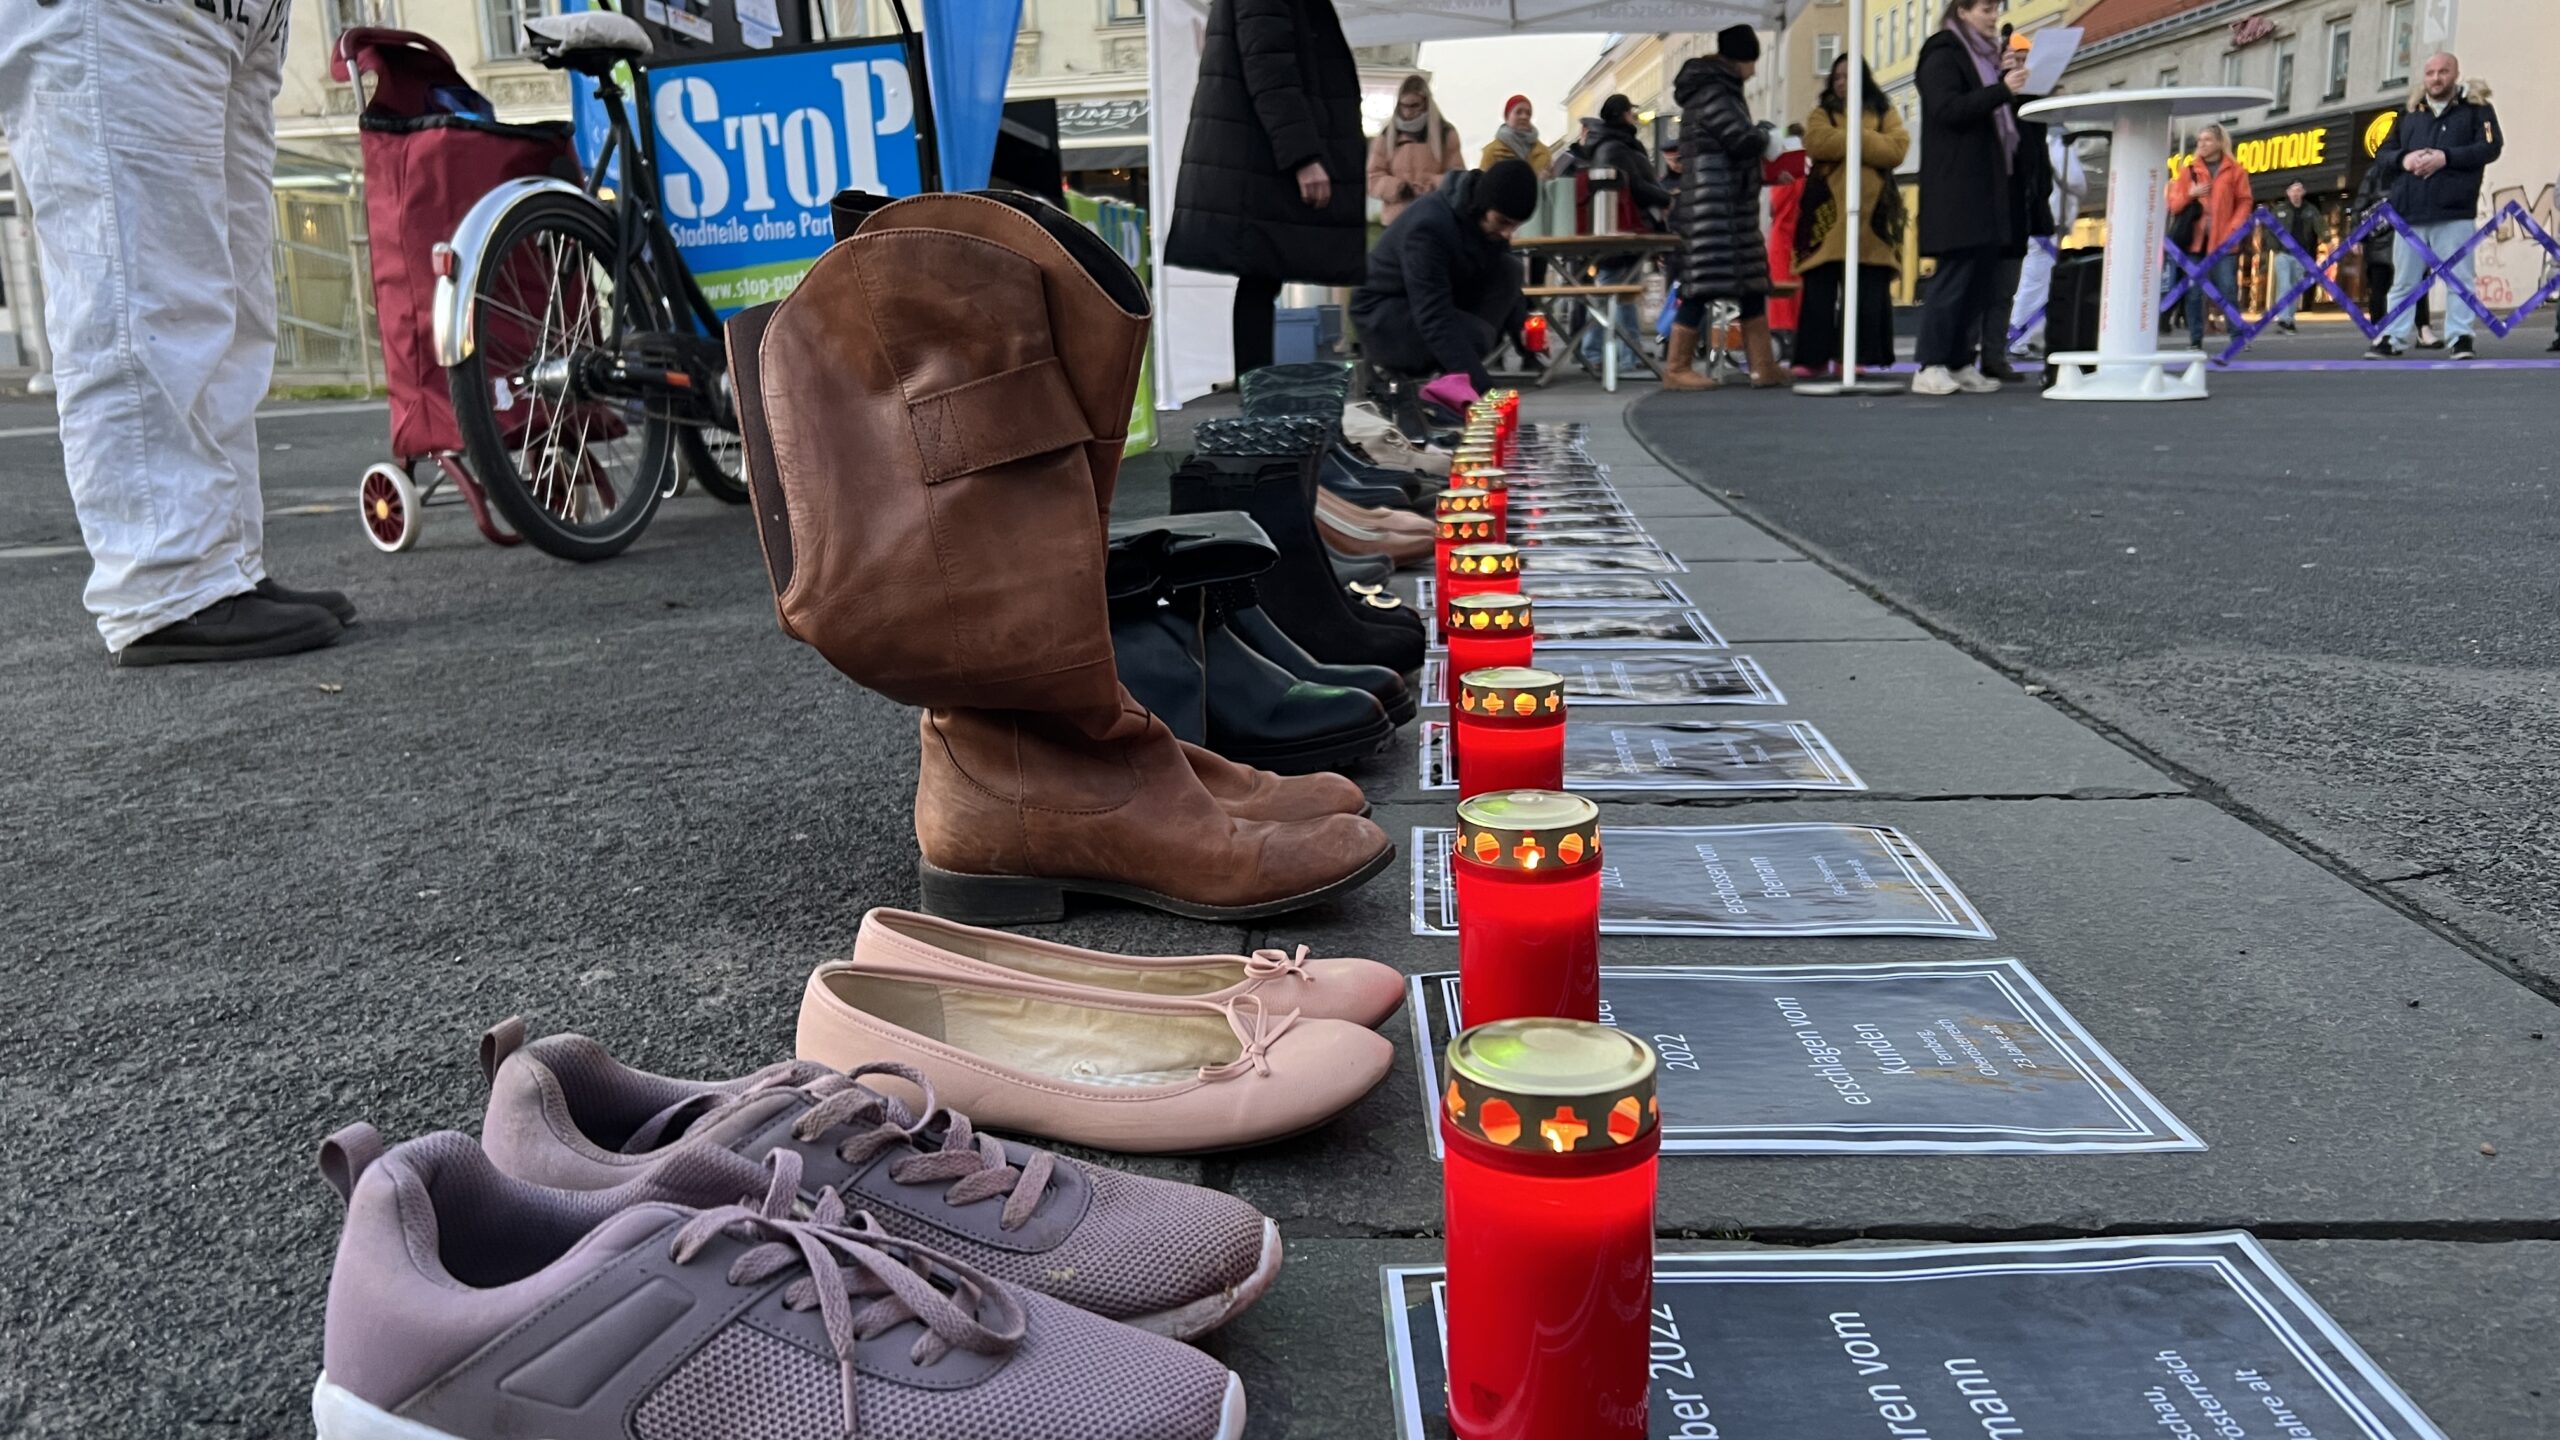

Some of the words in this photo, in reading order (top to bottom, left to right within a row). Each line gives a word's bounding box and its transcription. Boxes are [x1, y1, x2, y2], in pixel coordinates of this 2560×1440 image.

[2237, 128, 2327, 174] BOUTIQUE
[669, 215, 749, 248] Stadtteile
[752, 213, 796, 242] ohne
[799, 211, 834, 238] Part
[1695, 843, 1719, 865] vom
[1750, 856, 1792, 899] Ehemann
[1703, 863, 1748, 915] erschossen
[1774, 996, 1812, 1027] vom
[1981, 1023, 2002, 1036] alt
[1653, 1034, 1700, 1071] 2022
[1796, 1030, 1872, 1105] erschlagen
[1853, 1022, 1916, 1075] Kunden
[1937, 1018, 1999, 1077] Oberösterreich
[1996, 1033, 2027, 1058] Jahre
[2012, 1056, 2038, 1070] 23
[1648, 1303, 1695, 1380] 2022
[1829, 1311, 1889, 1376] vom
[1943, 1358, 2024, 1440] mann
[2154, 1350, 2245, 1440] österreich
[2235, 1368, 2271, 1392] alt
[1666, 1388, 1720, 1440] ber
[1867, 1384, 1931, 1440] ren
[2144, 1386, 2200, 1440] schau,
[2262, 1395, 2313, 1440] ahre
